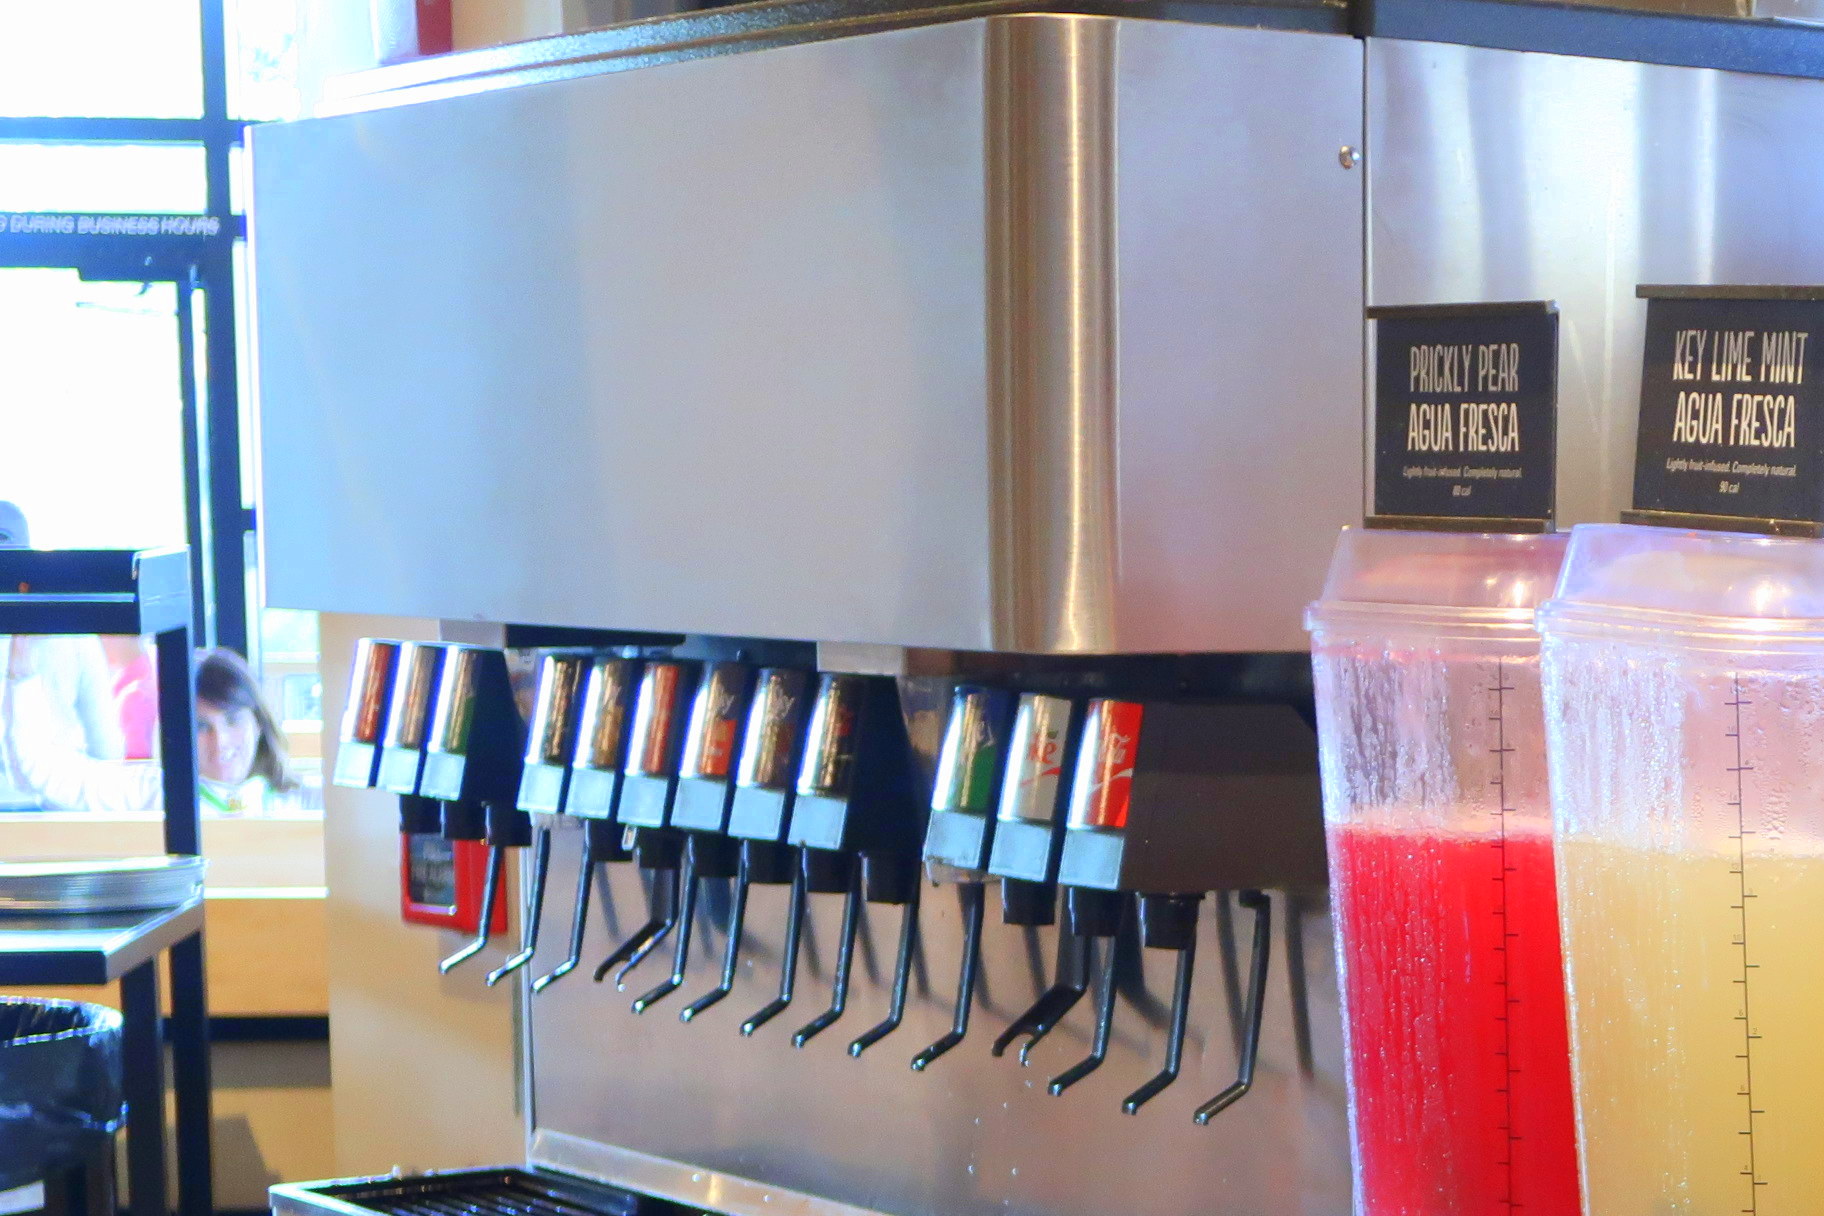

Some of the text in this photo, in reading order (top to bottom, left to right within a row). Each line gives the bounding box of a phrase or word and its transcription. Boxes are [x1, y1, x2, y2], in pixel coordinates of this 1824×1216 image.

[77, 215, 160, 236] BUSINESS
[161, 216, 220, 237] HOURS
[1409, 343, 1519, 393] PRICKLY PEAR
[1673, 329, 1809, 385] KEY LIME MINT
[1407, 402, 1520, 452] AGUA FRESCA
[1672, 390, 1796, 449] AGUA FRESCA
